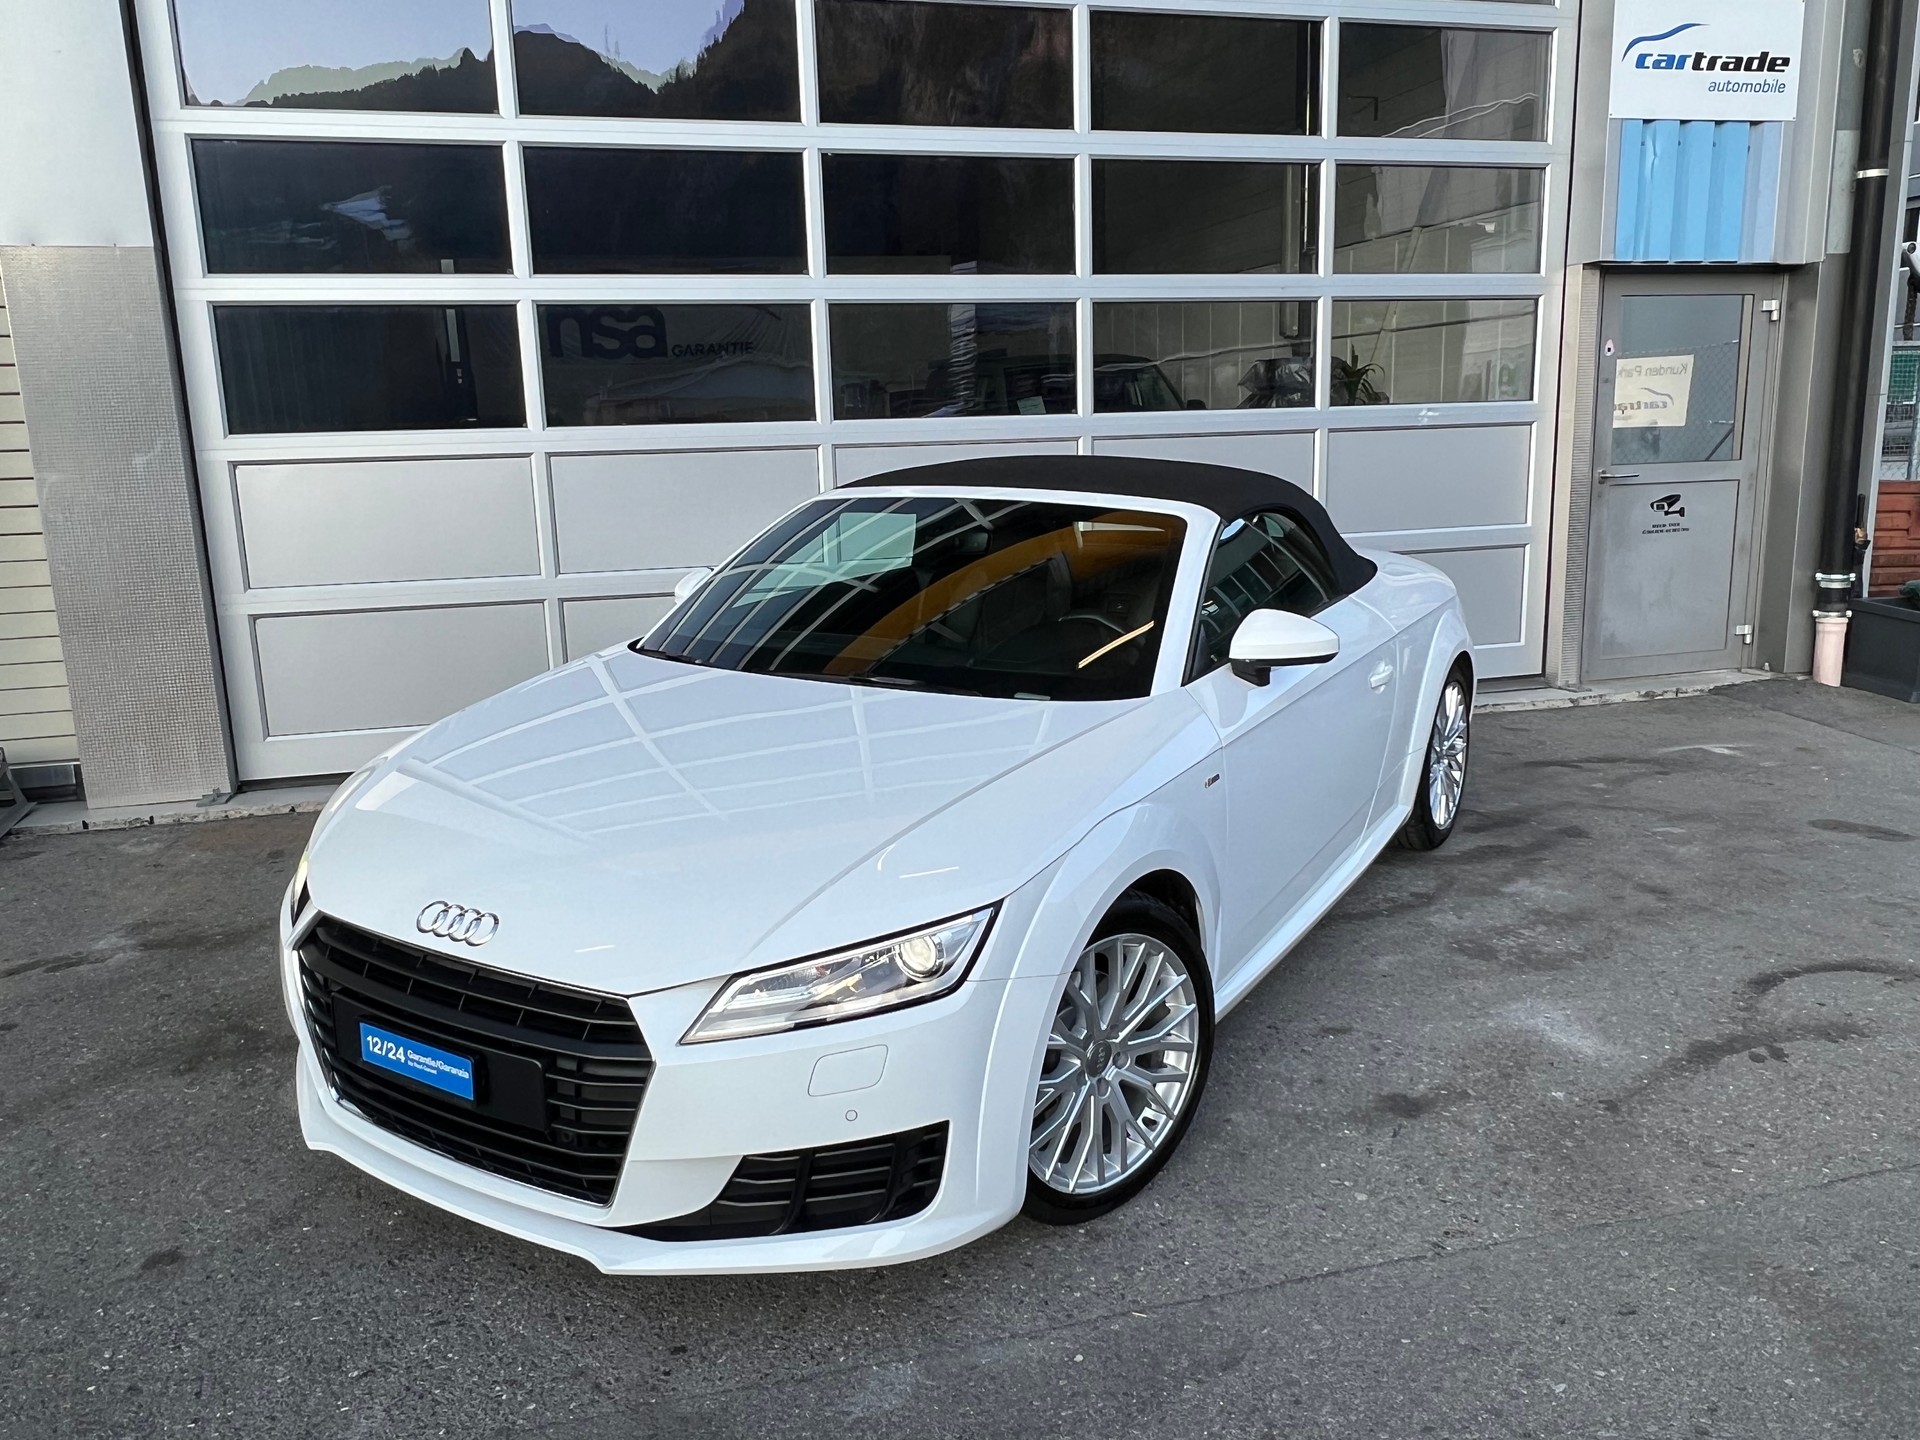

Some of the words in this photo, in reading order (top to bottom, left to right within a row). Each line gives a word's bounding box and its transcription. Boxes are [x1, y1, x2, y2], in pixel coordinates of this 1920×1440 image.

[1635, 51, 1791, 73] cartrade
[1708, 79, 1786, 94] automobile
[546, 306, 668, 359] nsa
[671, 341, 754, 358] GARANTIE
[366, 1035, 406, 1063] 12/24
